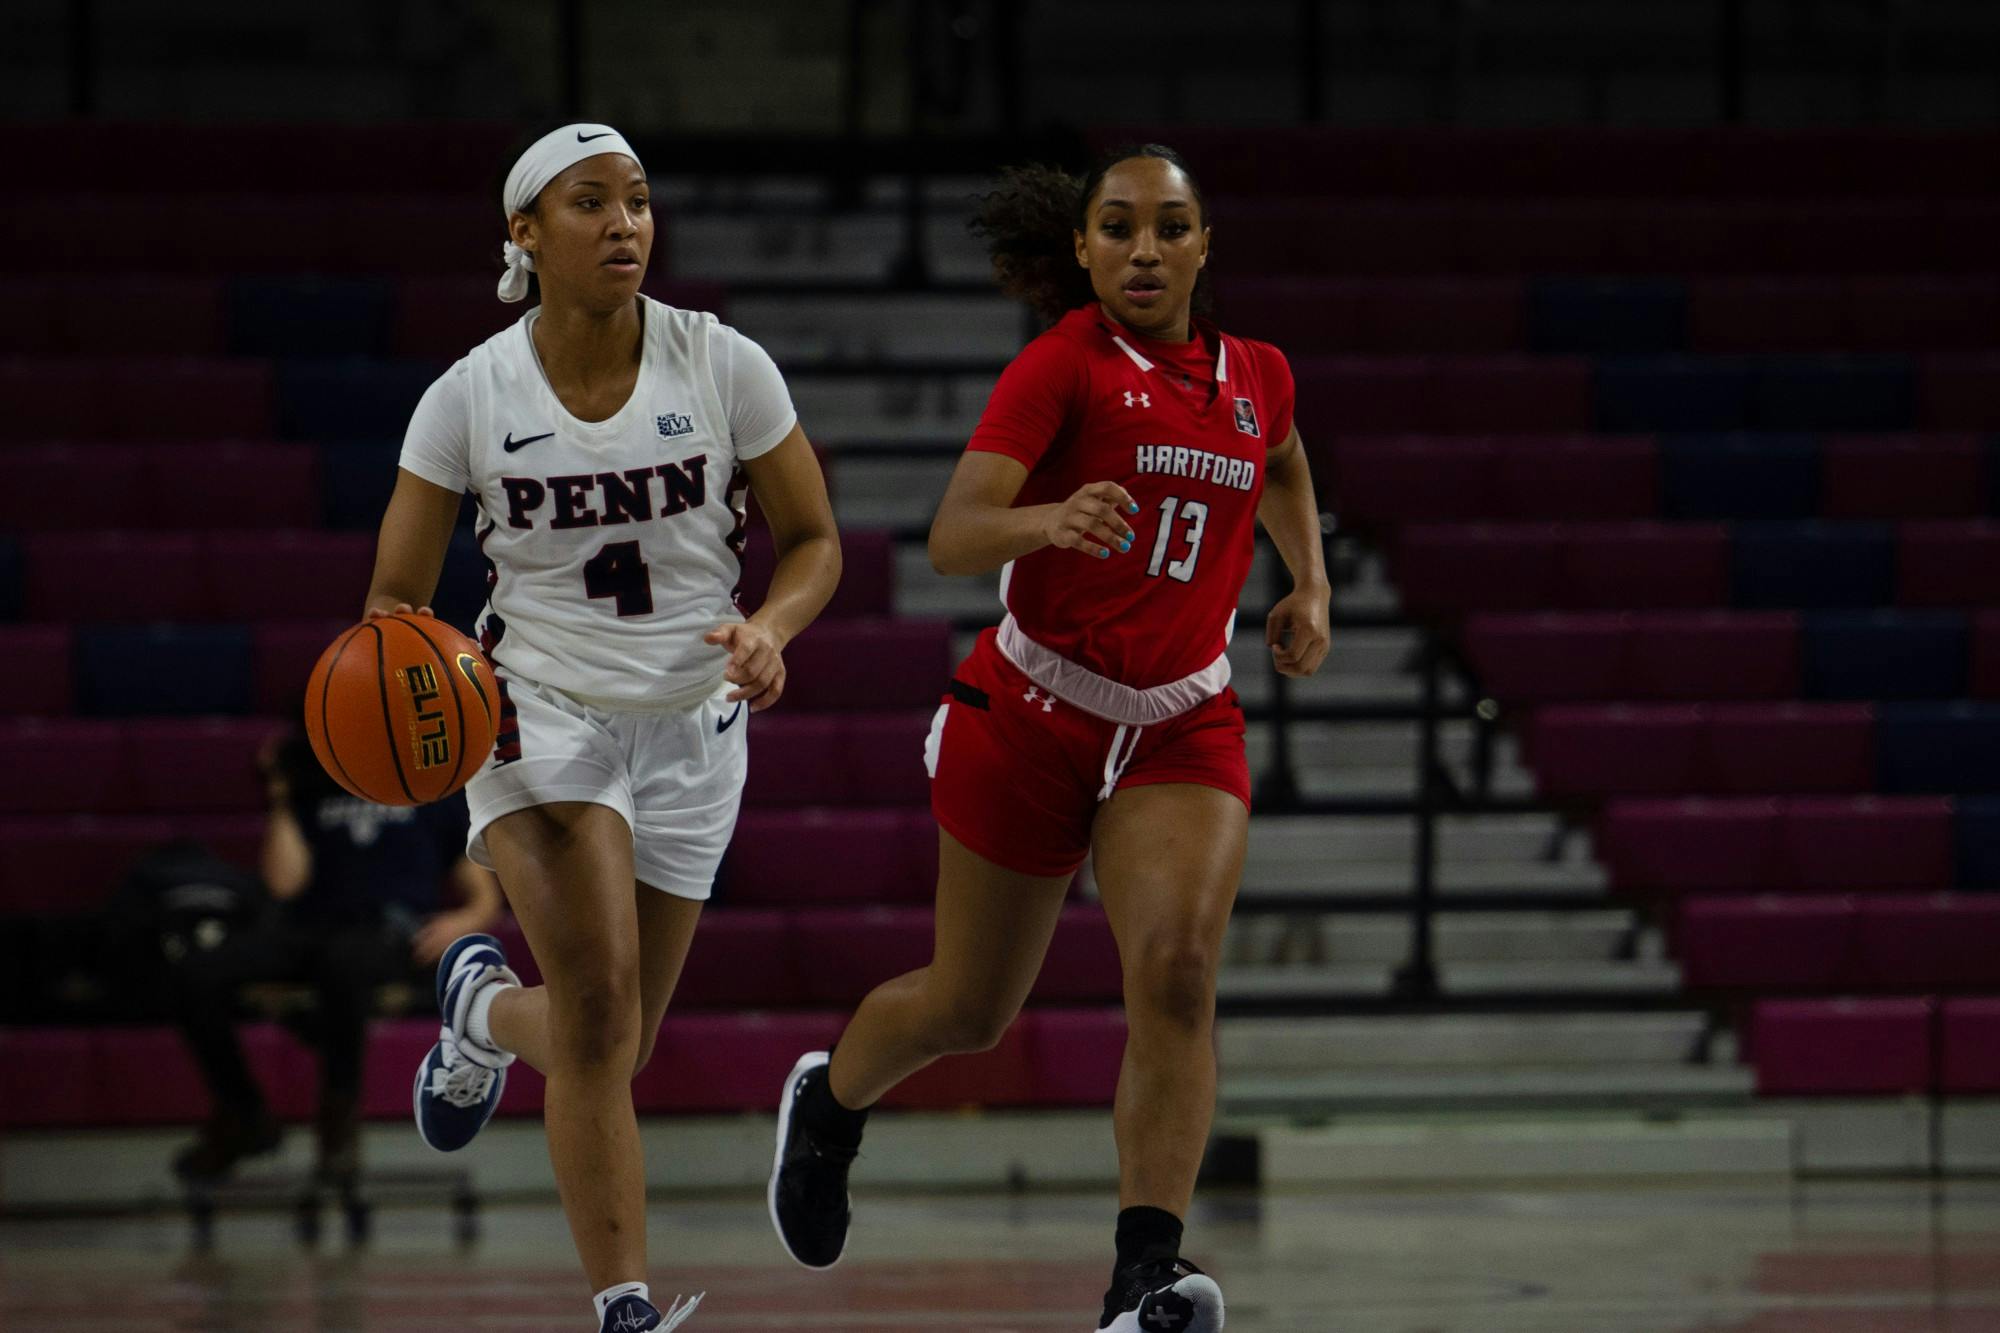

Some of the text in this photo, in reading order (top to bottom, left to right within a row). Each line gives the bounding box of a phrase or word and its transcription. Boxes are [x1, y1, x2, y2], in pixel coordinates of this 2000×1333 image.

[667, 415, 691, 431] IVY
[501, 454, 707, 530] PENN
[1136, 444, 1256, 491] HARTFORD
[1146, 496, 1209, 583] 13
[583, 540, 653, 616] 4
[405, 664, 450, 769] ELITE
